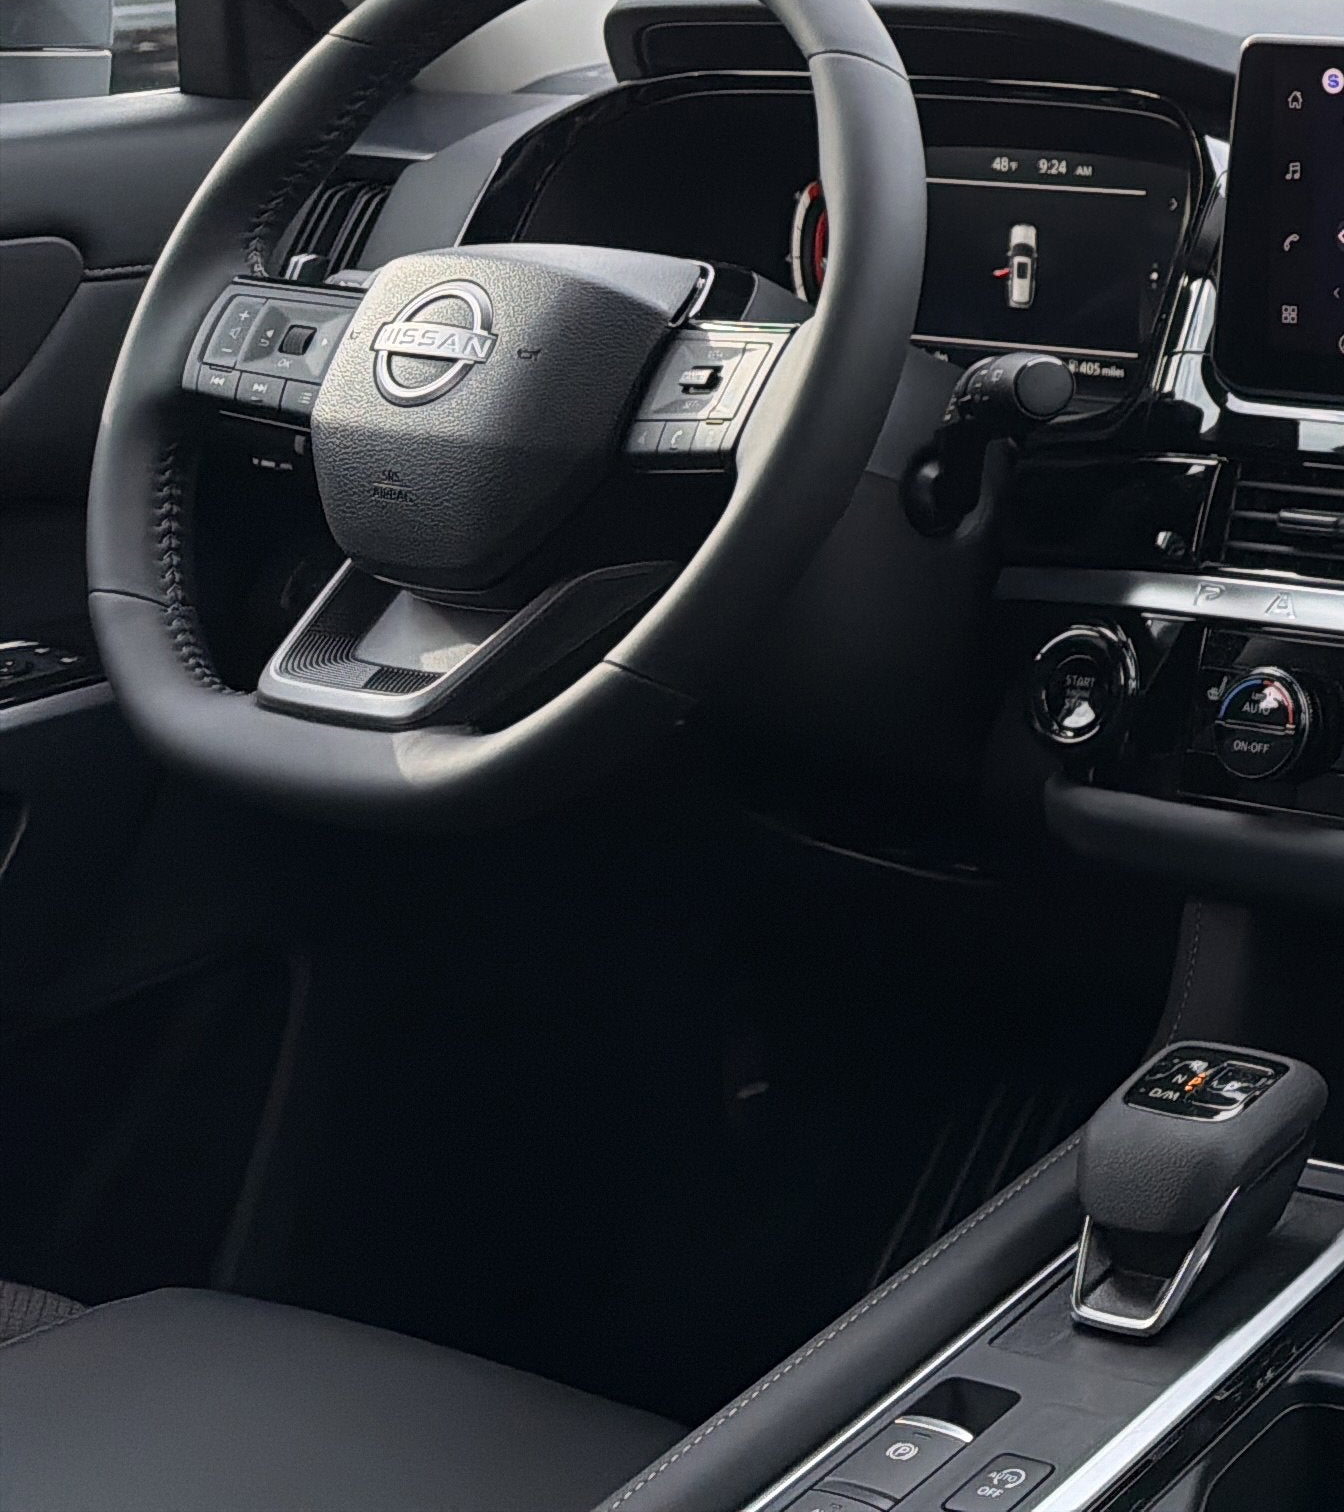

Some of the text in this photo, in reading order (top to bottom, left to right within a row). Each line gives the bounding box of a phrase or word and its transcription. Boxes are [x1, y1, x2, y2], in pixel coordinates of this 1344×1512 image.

[1038, 159, 1067, 175] 9:24
[1074, 165, 1093, 177] AM
[377, 325, 493, 359] NISSAN
[276, 358, 292, 369] OK
[1080, 361, 1125, 378] 405 miles
[1065, 674, 1096, 688] START
[1241, 702, 1271, 716] AUTO
[1148, 1088, 1181, 1101] D/M
[977, 1486, 1004, 1499] OFF
